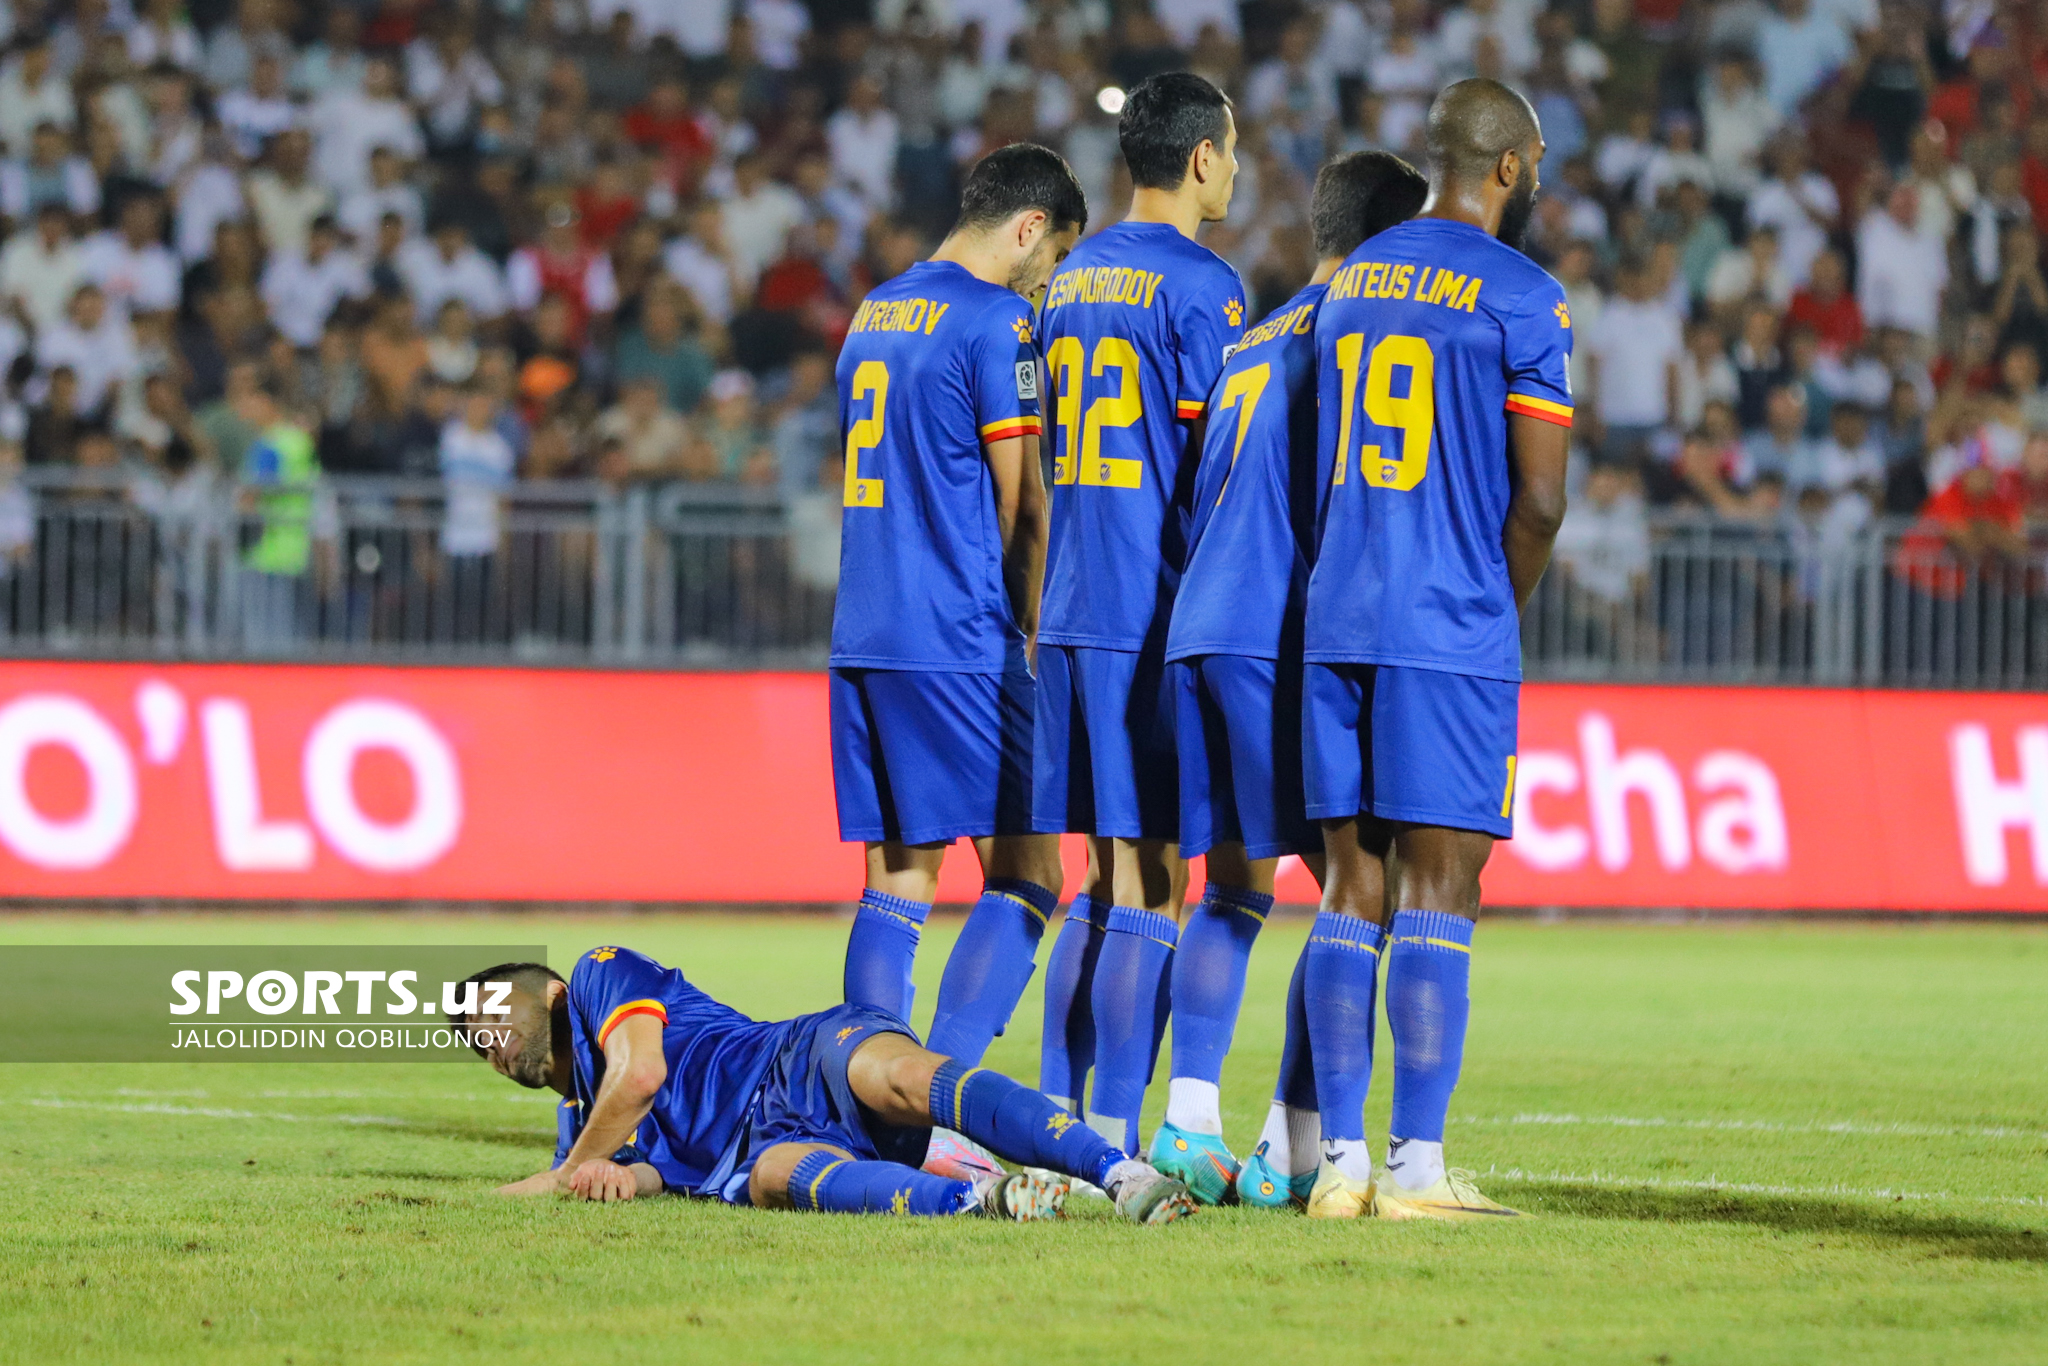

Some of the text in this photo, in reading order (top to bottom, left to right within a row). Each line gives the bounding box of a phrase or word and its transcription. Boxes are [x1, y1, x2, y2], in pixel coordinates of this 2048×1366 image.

[1046, 266, 1164, 309] ESHMURODOV
[1326, 262, 1483, 313] MATEUS LIMA
[843, 361, 889, 508] 2
[1046, 336, 1143, 489] 92
[1216, 362, 1271, 506] 7
[1333, 333, 1434, 491] 19
